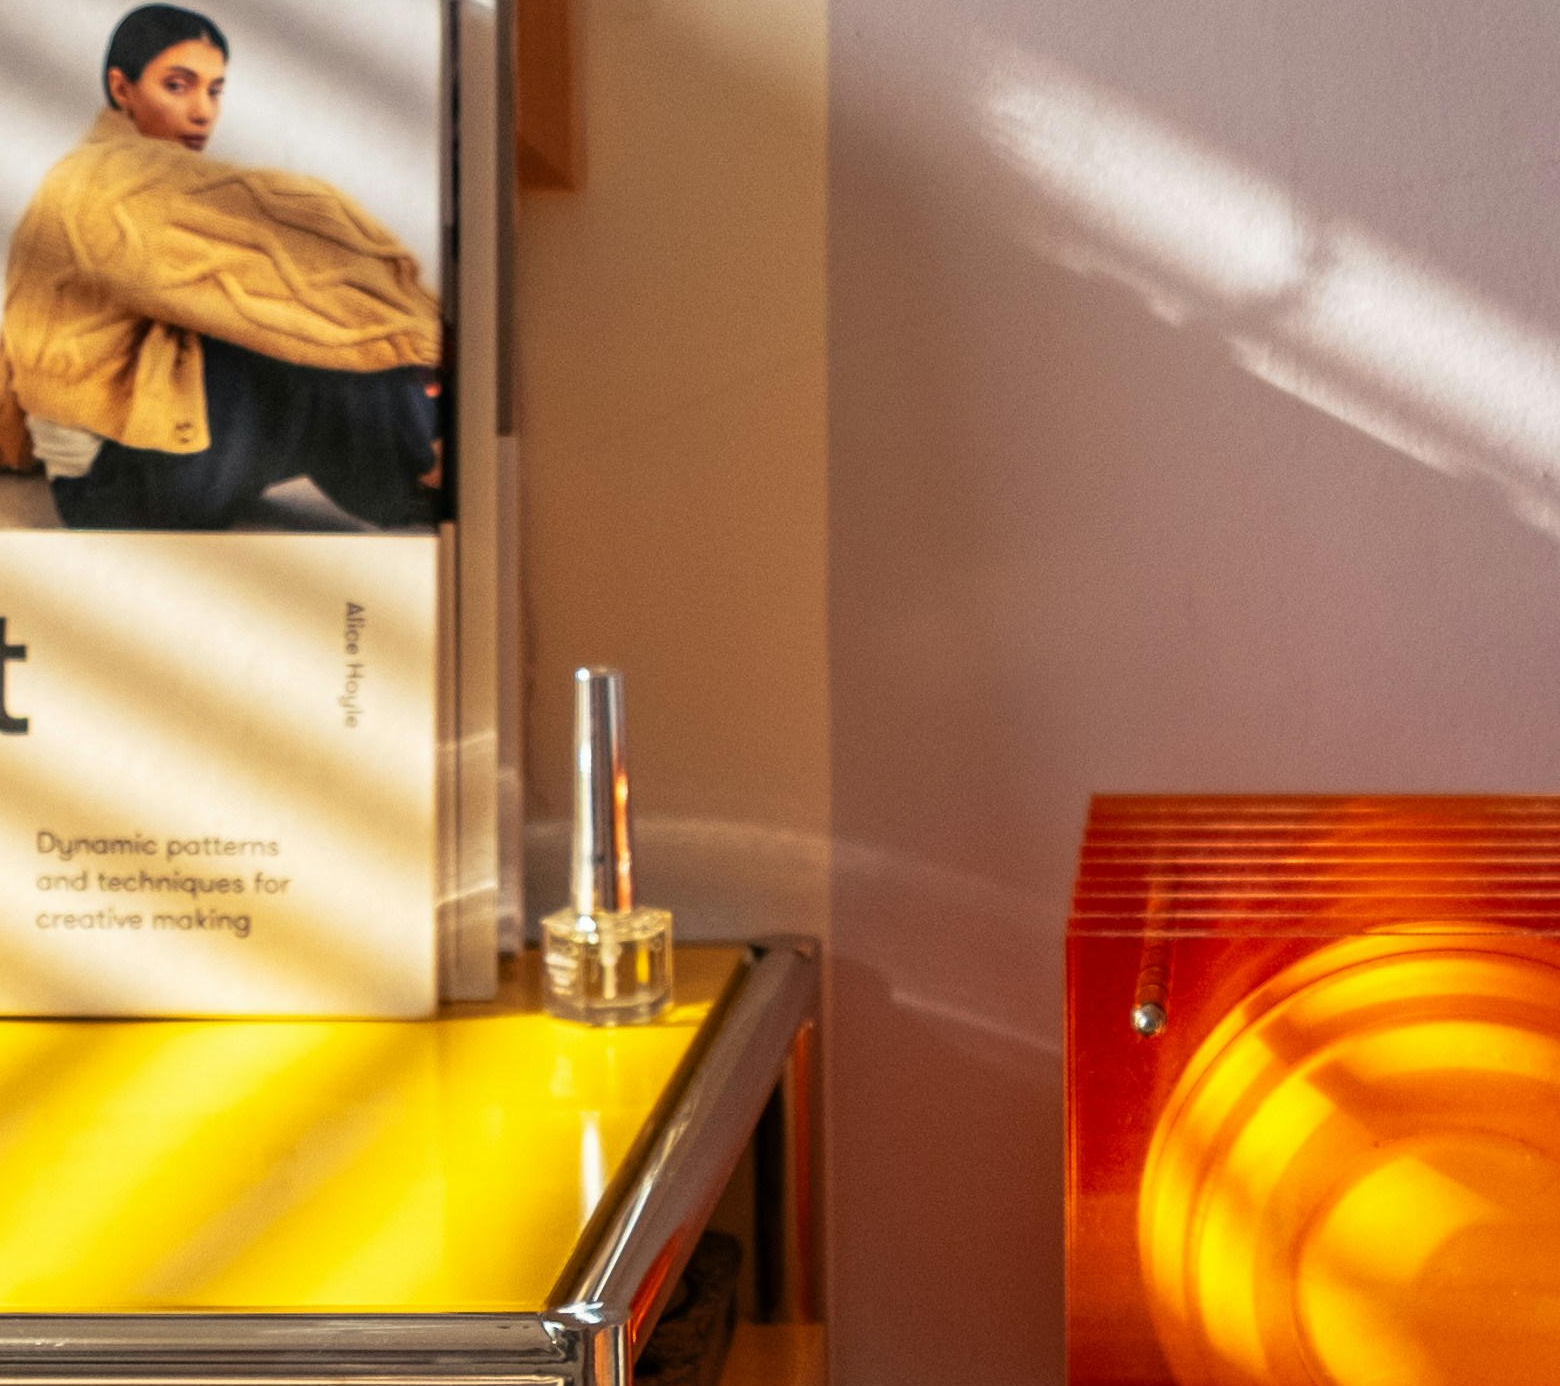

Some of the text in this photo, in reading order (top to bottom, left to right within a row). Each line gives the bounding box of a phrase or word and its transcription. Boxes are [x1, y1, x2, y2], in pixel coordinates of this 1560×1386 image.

[339, 600, 364, 729] Alice Hoyle
[35, 830, 281, 862] Dynamic patterns
[35, 868, 292, 899] and techniques for
[35, 908, 252, 939] creative making
